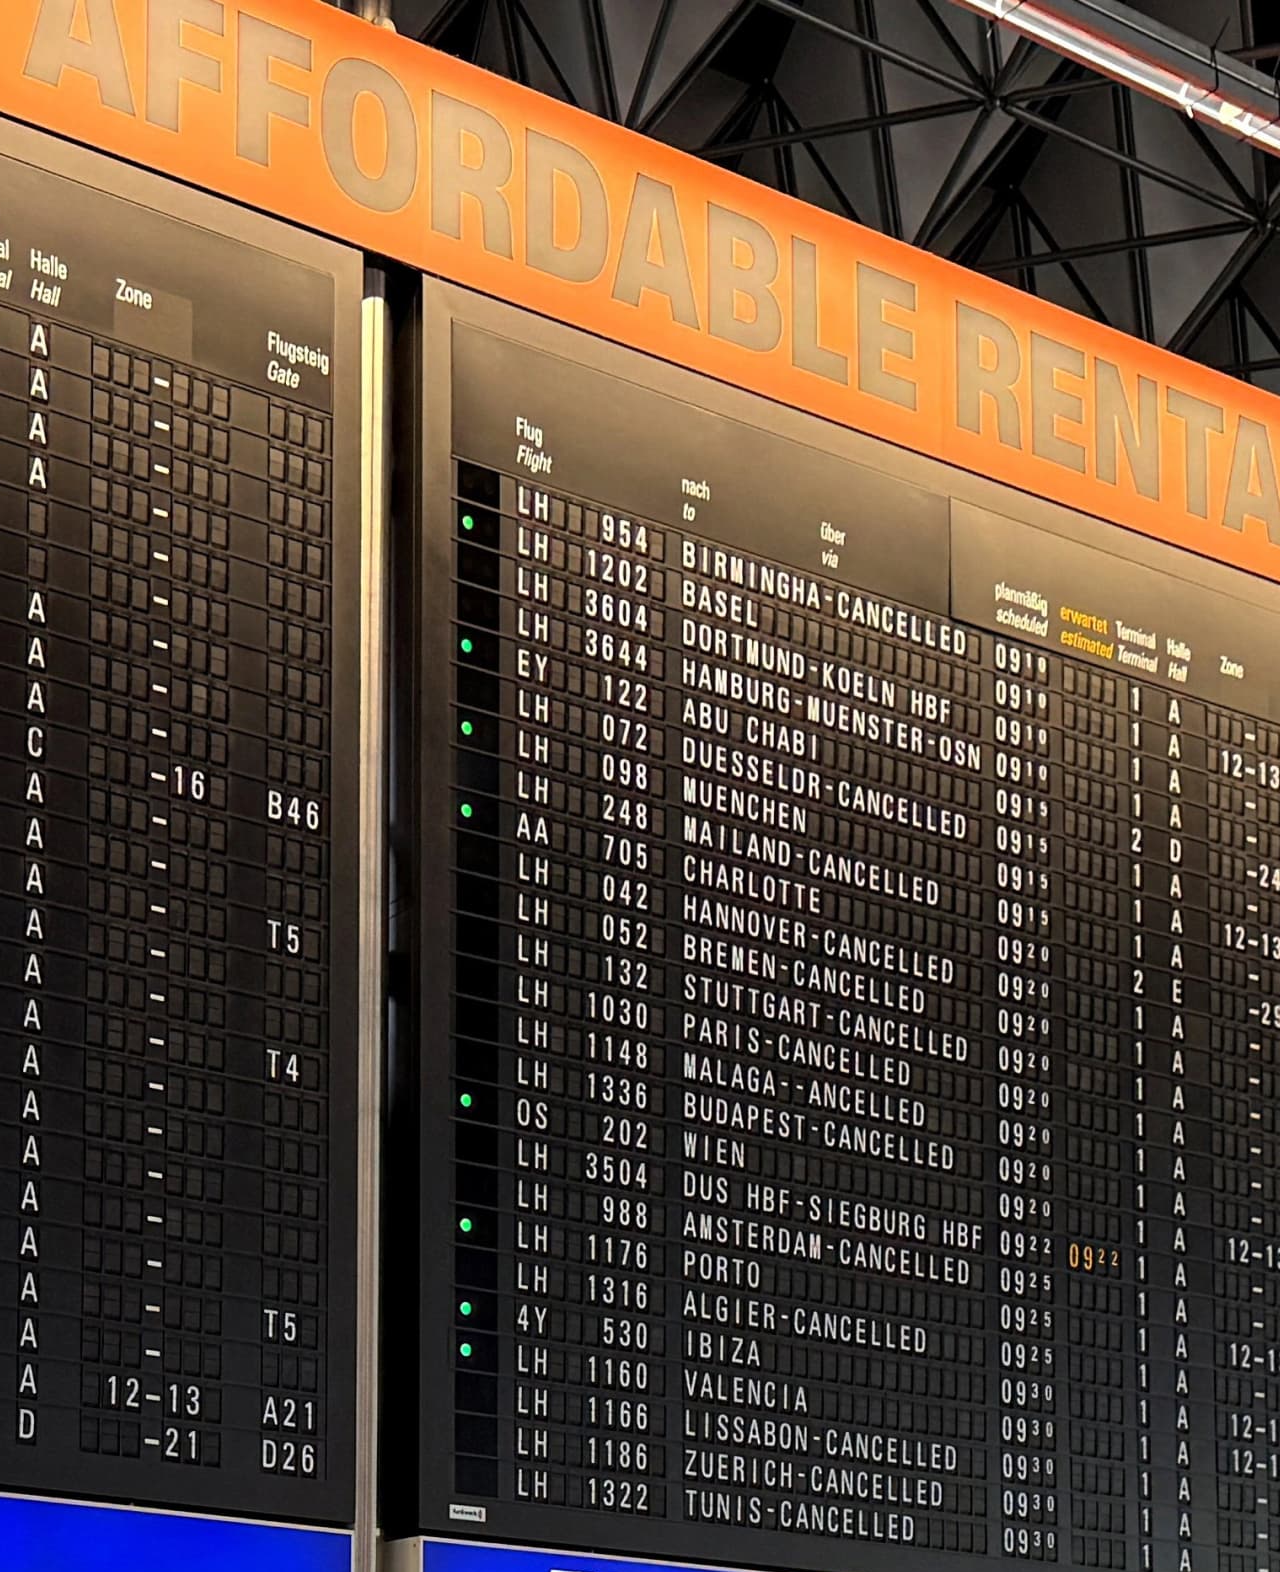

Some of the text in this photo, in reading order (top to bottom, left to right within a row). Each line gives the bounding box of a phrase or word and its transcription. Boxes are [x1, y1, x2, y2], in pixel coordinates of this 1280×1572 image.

[23, 0, 916, 413] AFFORDABLE
[30, 248, 68, 280] Halle
[30, 280, 61, 307] Hall
[116, 278, 153, 309] Zone
[267, 331, 329, 376] Flugsteig
[267, 360, 300, 389] Gate
[516, 417, 543, 448] Flug
[516, 445, 553, 474] Flight
[681, 479, 710, 501] nach
[682, 502, 696, 521] to
[602, 515, 965, 655] 954 BIRMINGHA-CANCELLED
[683, 580, 757, 627] BASEL
[683, 619, 950, 723] DORTMUND-KOELN HBF
[683, 699, 816, 760] ABU CHABI
[269, 791, 318, 829] B46
[684, 776, 805, 832] MUENCHEN
[684, 855, 819, 913] CHARLOTTE
[268, 920, 299, 953] T5
[685, 895, 952, 983] HANNOVER-CANCELLED
[685, 974, 966, 1060] STUTTGART-CANCELLED
[267, 1050, 298, 1081] T4
[684, 1014, 909, 1085] PARIS-CANCELLED
[685, 1092, 952, 1169] BUDAPEST-CANCELLED
[685, 1132, 744, 1167] WIEN
[685, 1172, 981, 1248] DUS HBF-SIEGBURG HBF
[685, 1251, 759, 1287] PORTO
[689, 1331, 759, 1366] IBIZA
[109, 1376, 199, 1414] 12-13
[263, 1397, 311, 1429] A21
[685, 1370, 806, 1411] VALENCIA
[263, 1440, 313, 1472] D26
[686, 1410, 956, 1469] LISSABON-CANCELLED
[589, 1479, 913, 1540] 1322 TUNIS-CANCELLED
